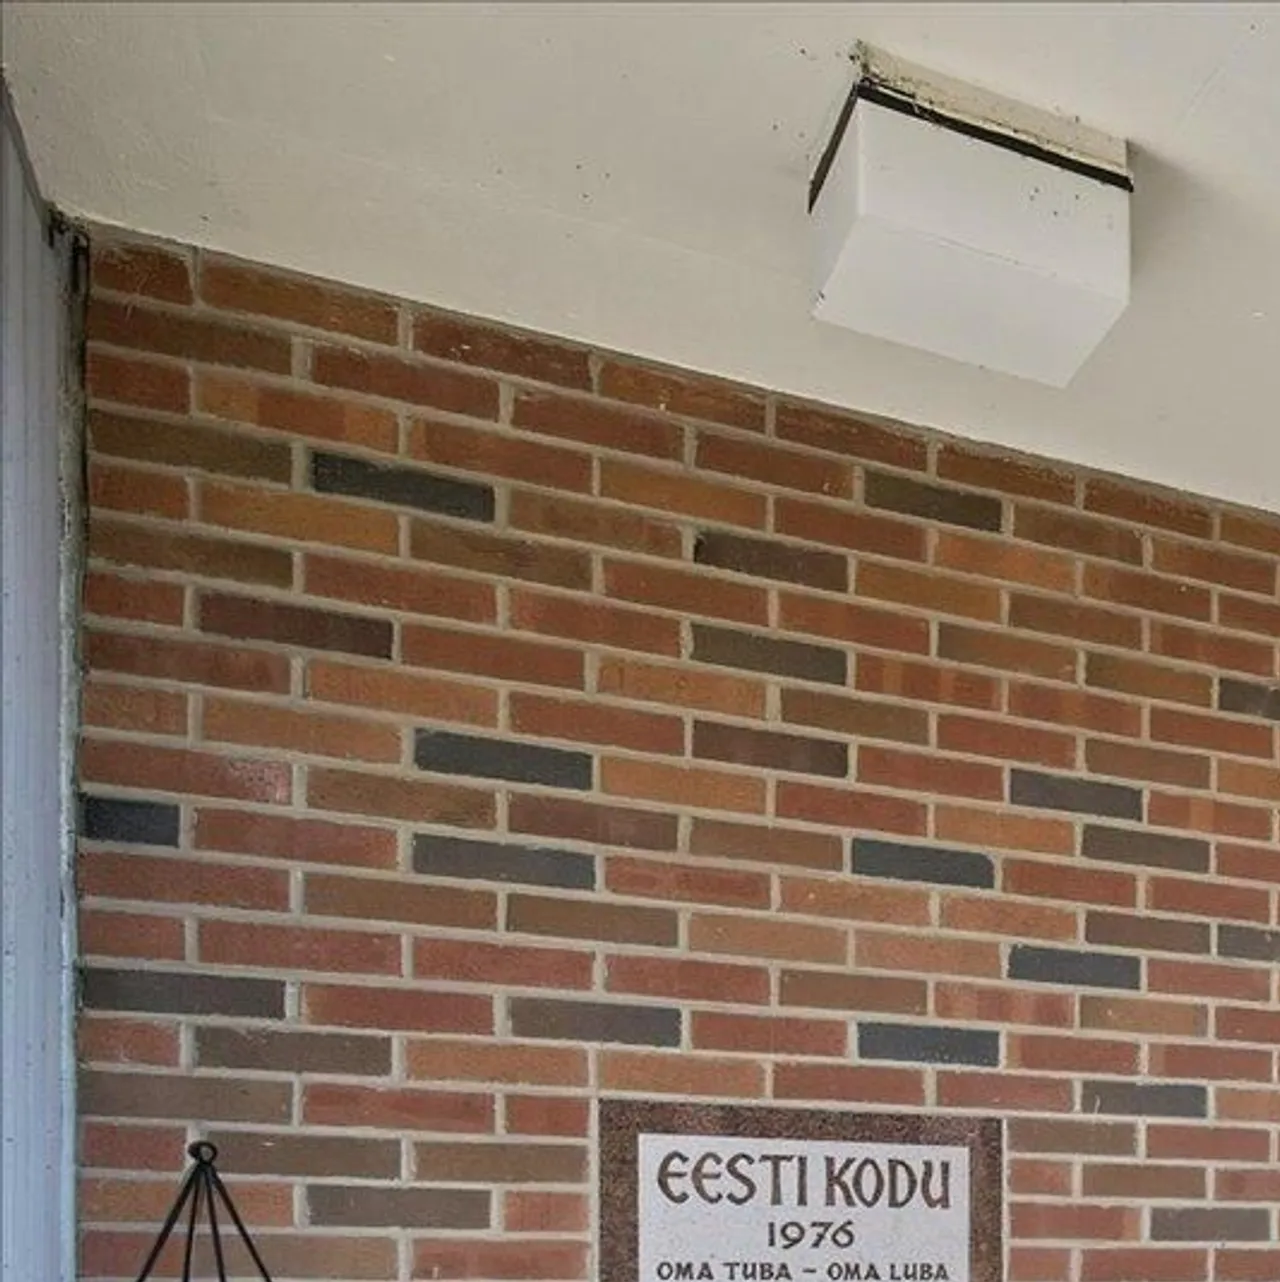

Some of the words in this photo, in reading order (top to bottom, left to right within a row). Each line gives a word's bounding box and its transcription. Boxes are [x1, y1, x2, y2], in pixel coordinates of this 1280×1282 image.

[656, 1150, 807, 1206] EESTI
[824, 1154, 951, 1209] KODU
[766, 1220, 855, 1249] 1976
[656, 1262, 714, 1281] OMA
[723, 1262, 792, 1281] TUBA
[827, 1263, 880, 1281] OMA
[890, 1263, 950, 1281] LUBA
